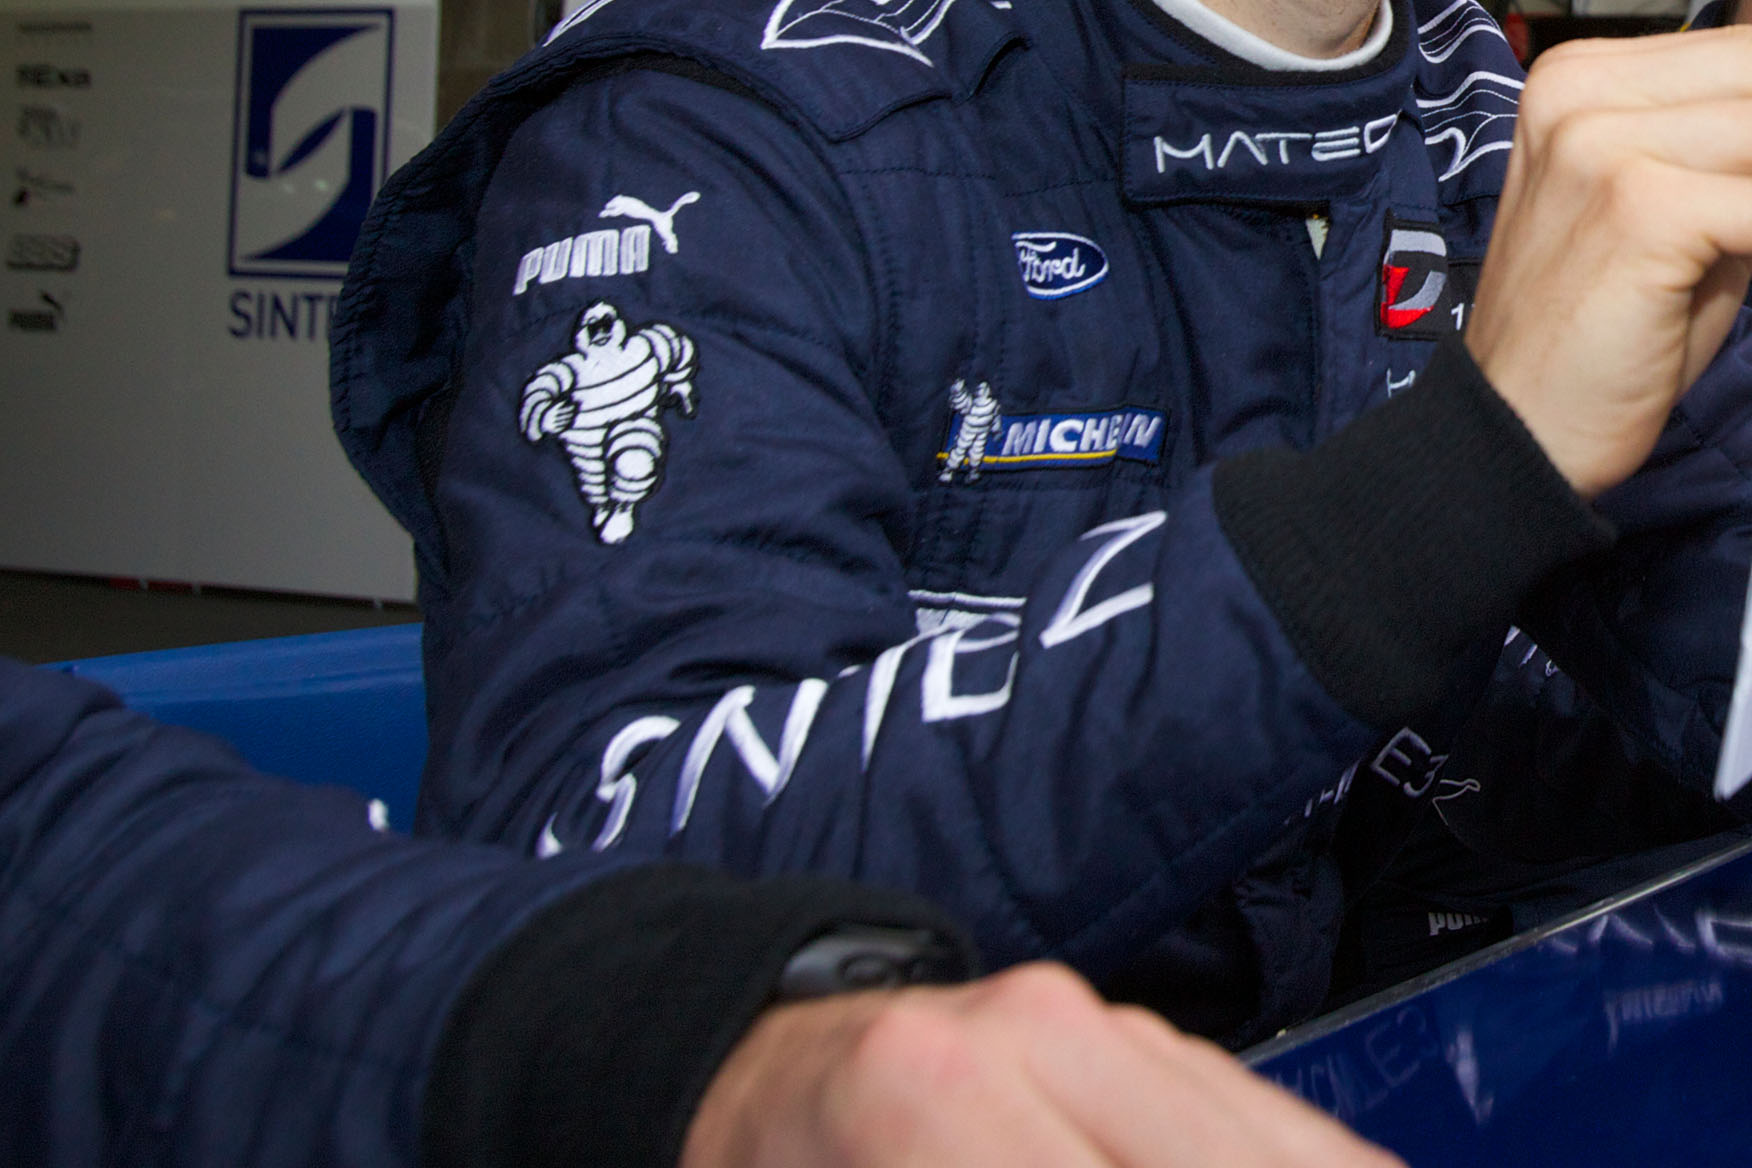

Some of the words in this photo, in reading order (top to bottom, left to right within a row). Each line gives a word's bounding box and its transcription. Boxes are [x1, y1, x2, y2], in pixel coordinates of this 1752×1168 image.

[512, 224, 652, 297] PUMA
[1015, 241, 1086, 284] Ford
[1002, 412, 1163, 458] MICHEIN
